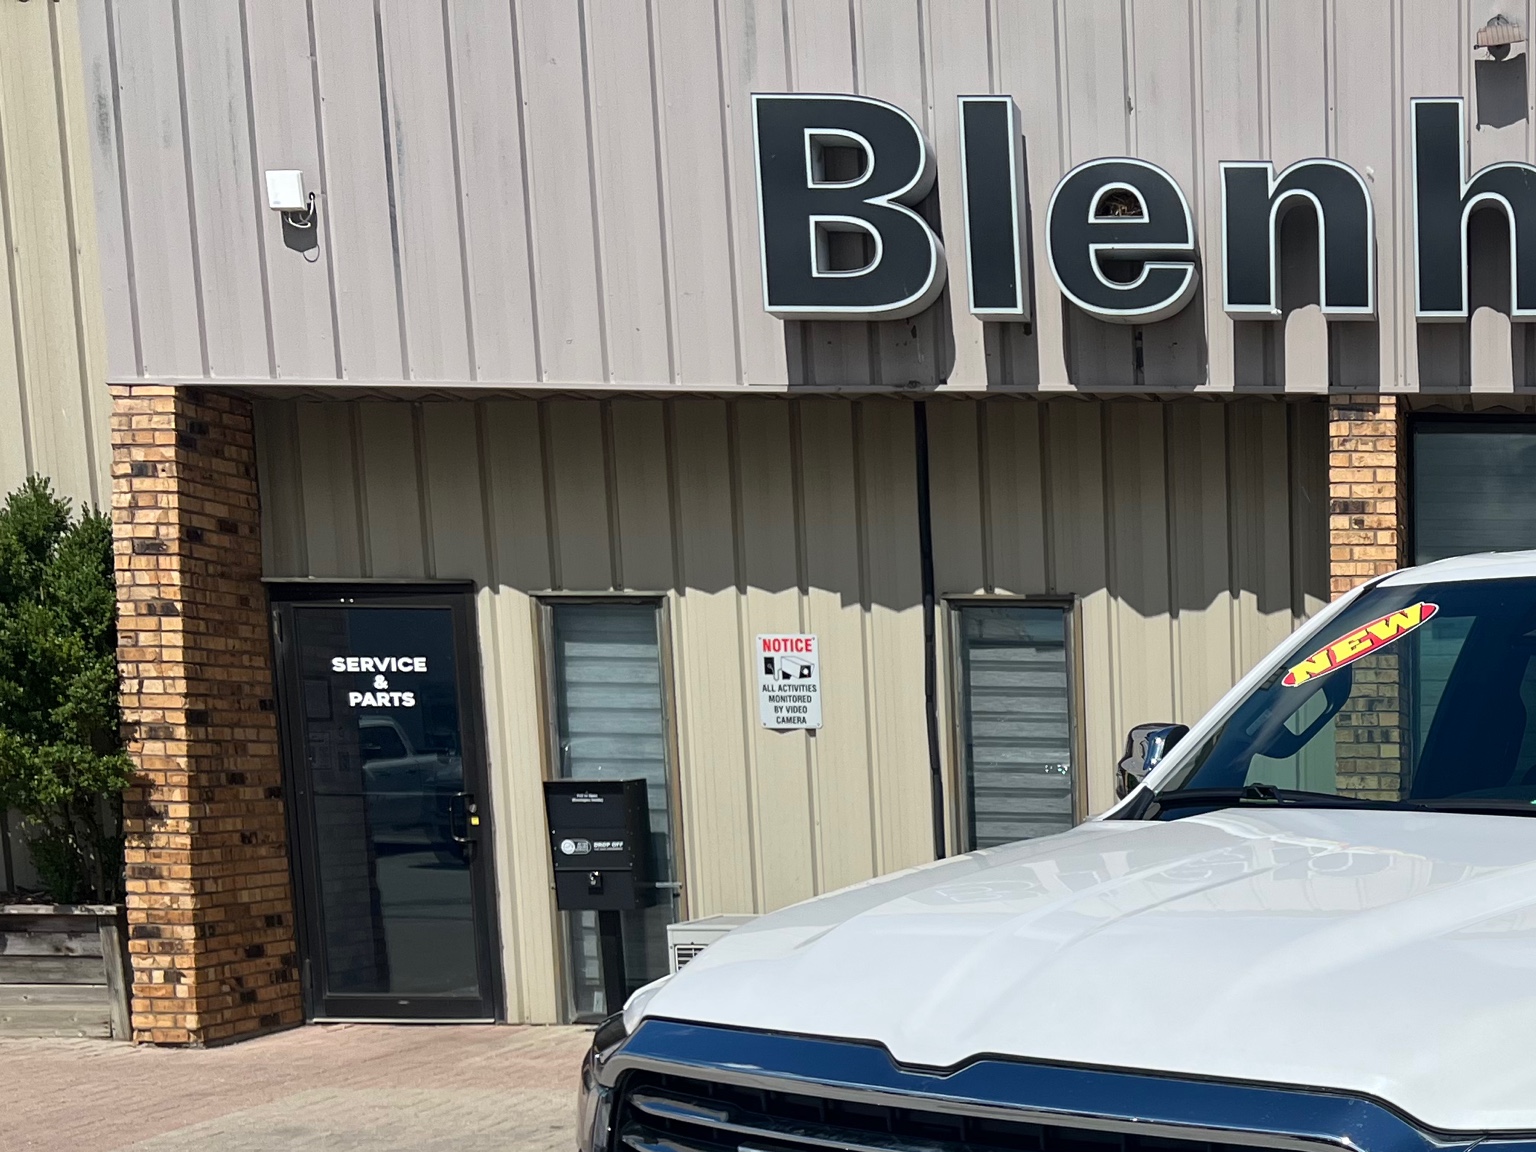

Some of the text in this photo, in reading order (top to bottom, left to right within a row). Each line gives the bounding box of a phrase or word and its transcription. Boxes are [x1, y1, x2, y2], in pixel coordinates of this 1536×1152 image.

[762, 638, 812, 652] NOTICE
[1289, 602, 1423, 686] NEW
[331, 656, 428, 672] SERVICE
[373, 674, 389, 690] &
[762, 684, 817, 693] ALL ACTIVITIES
[348, 691, 416, 707] PARTS
[768, 695, 812, 704] MONITORED
[774, 705, 808, 714] BY VIDEO
[776, 716, 807, 725] CAMERA
